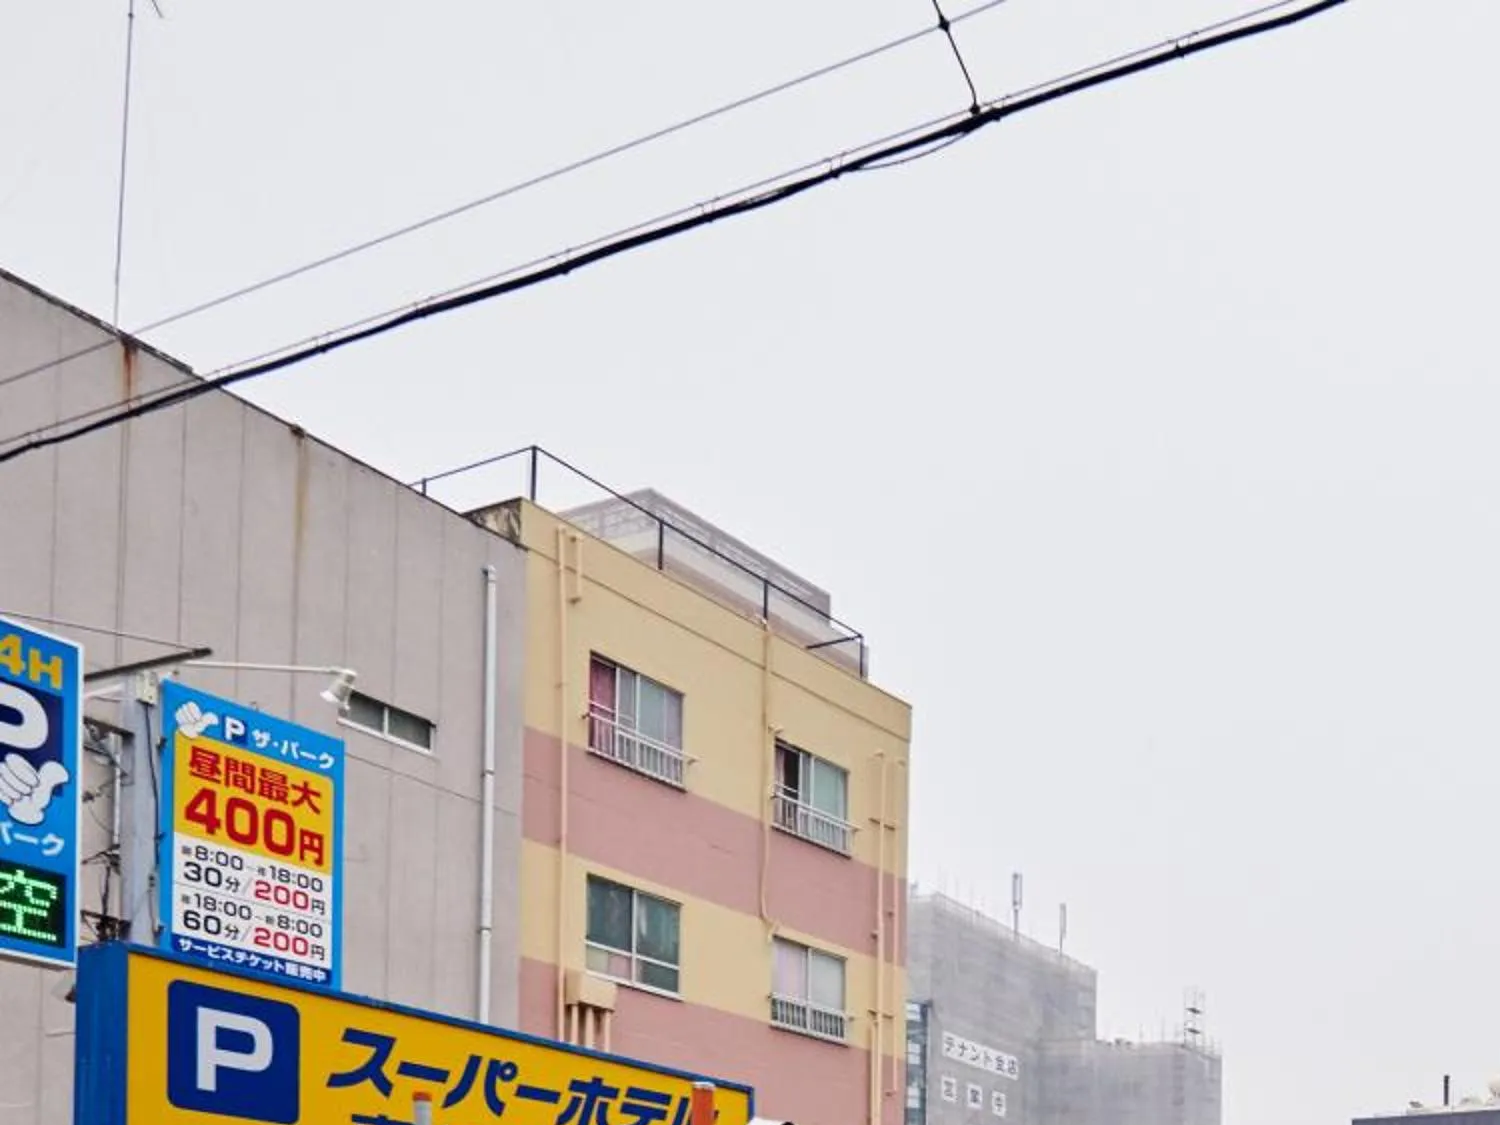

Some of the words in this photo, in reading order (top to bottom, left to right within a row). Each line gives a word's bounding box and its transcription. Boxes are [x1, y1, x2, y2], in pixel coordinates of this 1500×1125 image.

[188, 745, 322, 816] 昼間最大
[184, 787, 324, 868] 400円
[178, 938, 327, 983] サービスチケット販売中
[197, 1006, 274, 1092] P
